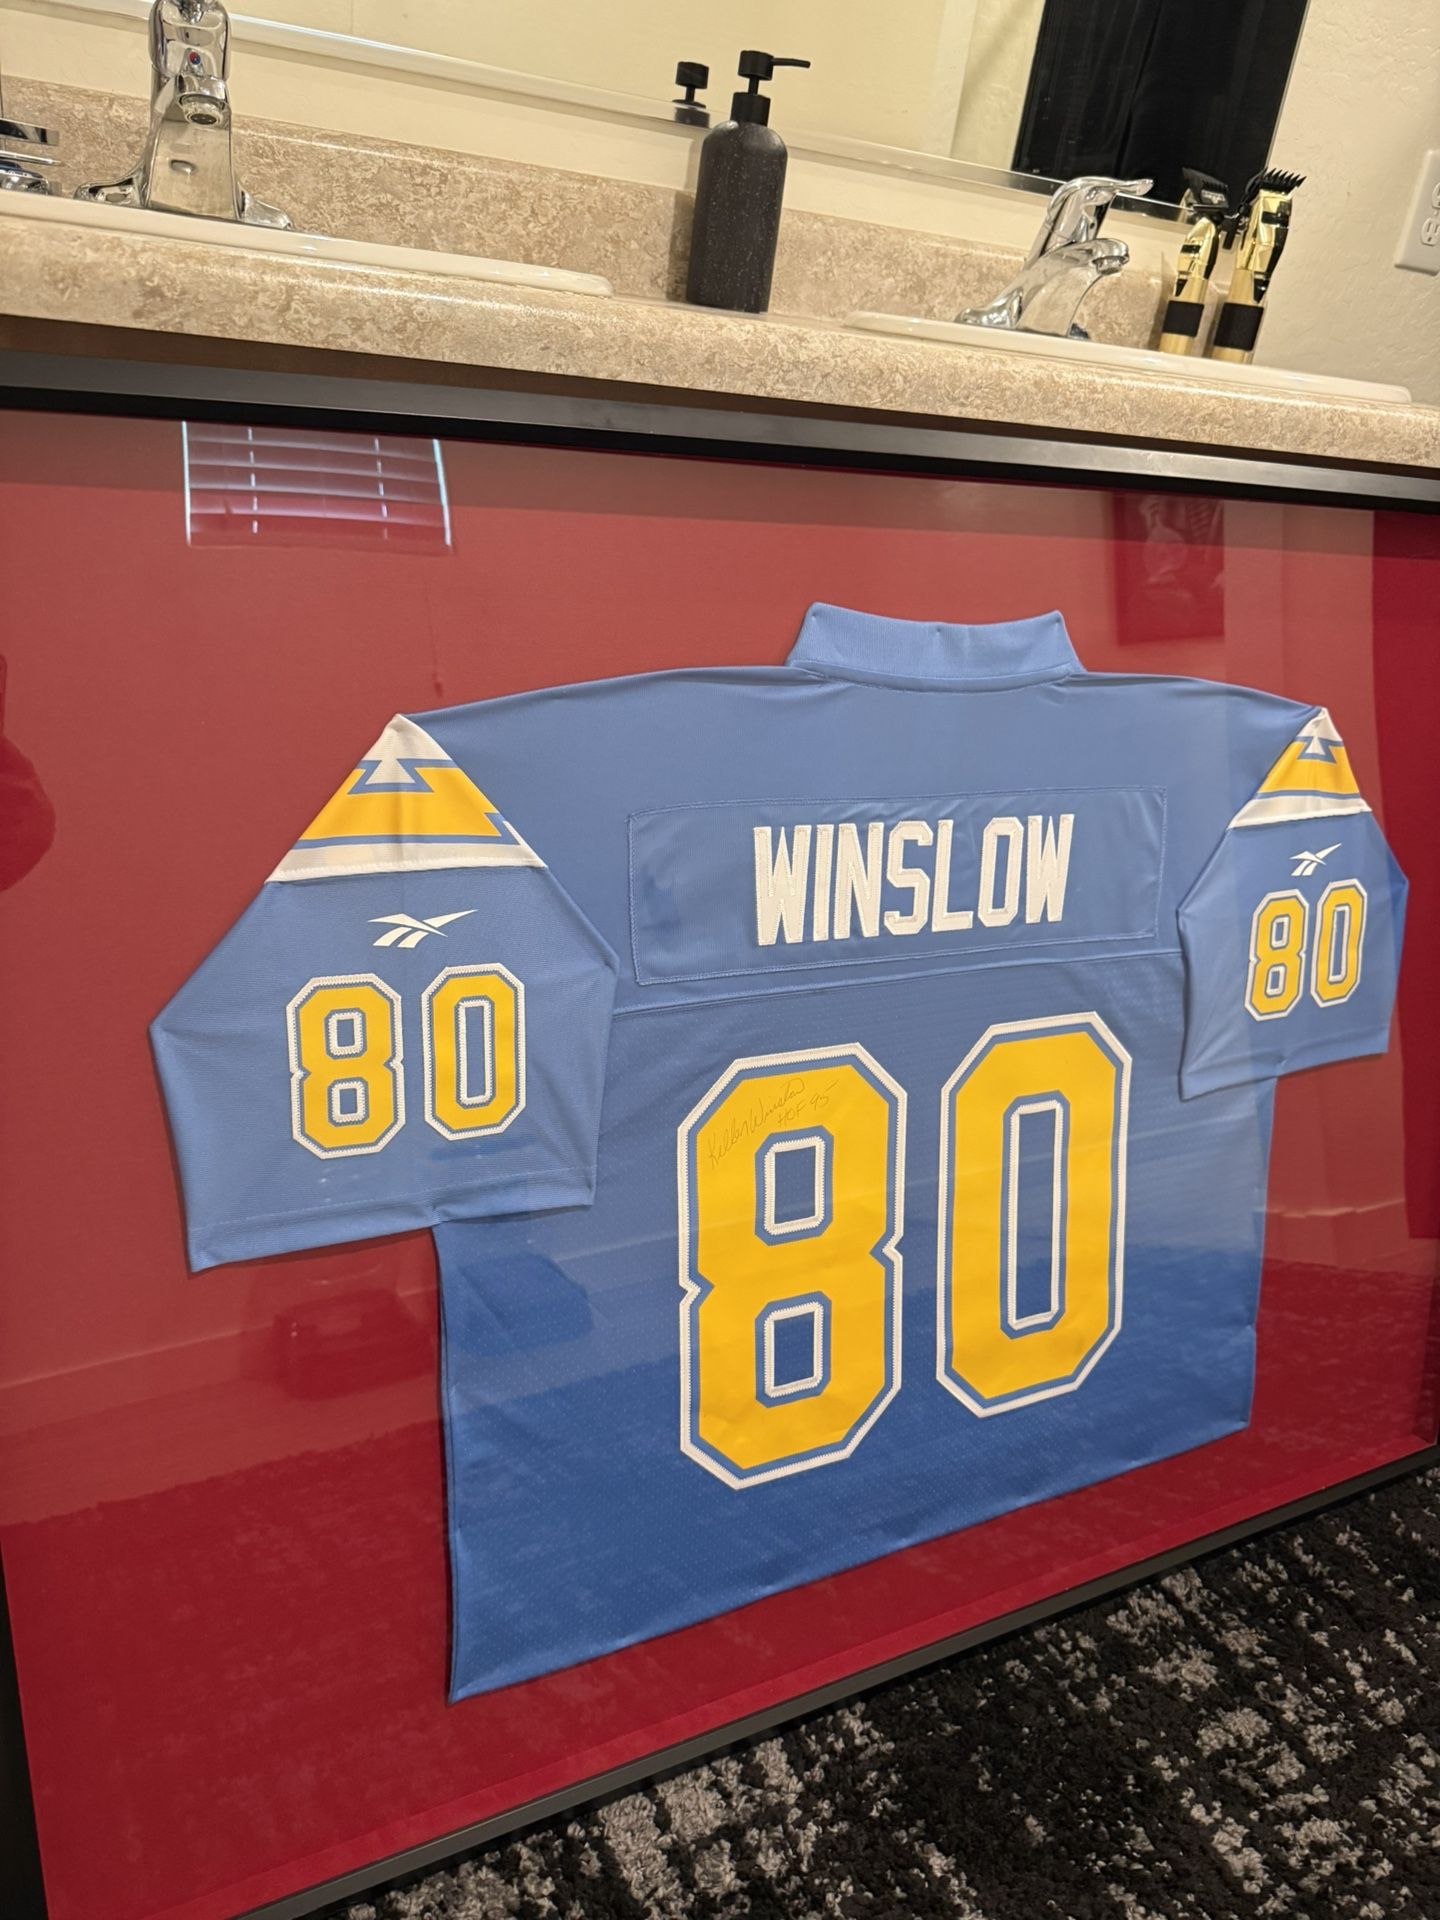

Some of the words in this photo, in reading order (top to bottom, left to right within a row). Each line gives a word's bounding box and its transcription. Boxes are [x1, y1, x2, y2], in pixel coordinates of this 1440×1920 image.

[753, 813, 1075, 946] WINSLOW
[1245, 878, 1368, 1022] 80
[286, 962, 526, 1160] 80
[676, 1011, 1132, 1490] 80
